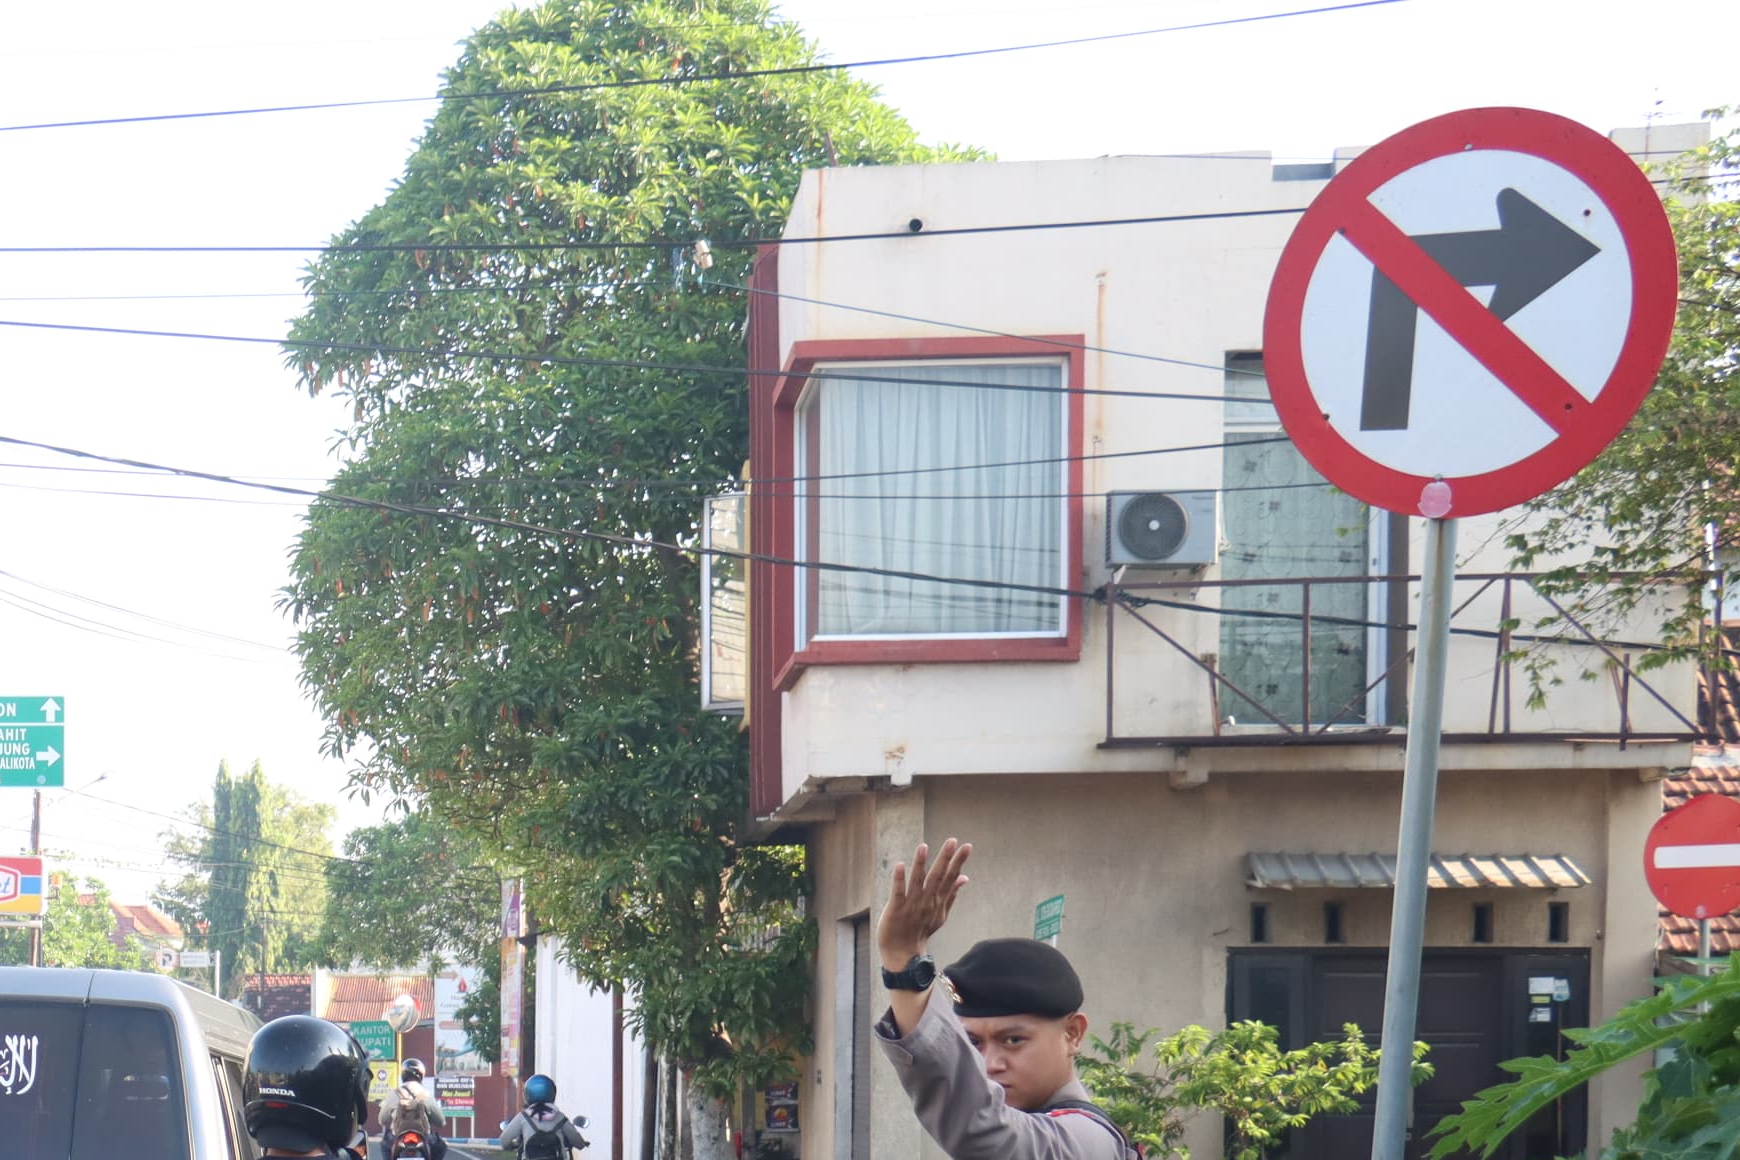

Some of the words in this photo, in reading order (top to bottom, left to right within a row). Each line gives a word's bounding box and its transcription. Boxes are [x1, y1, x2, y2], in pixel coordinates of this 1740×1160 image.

[353, 1025, 390, 1034] KANTOR
[360, 1036, 391, 1046] UPATI
[259, 1087, 296, 1097] HONDA
